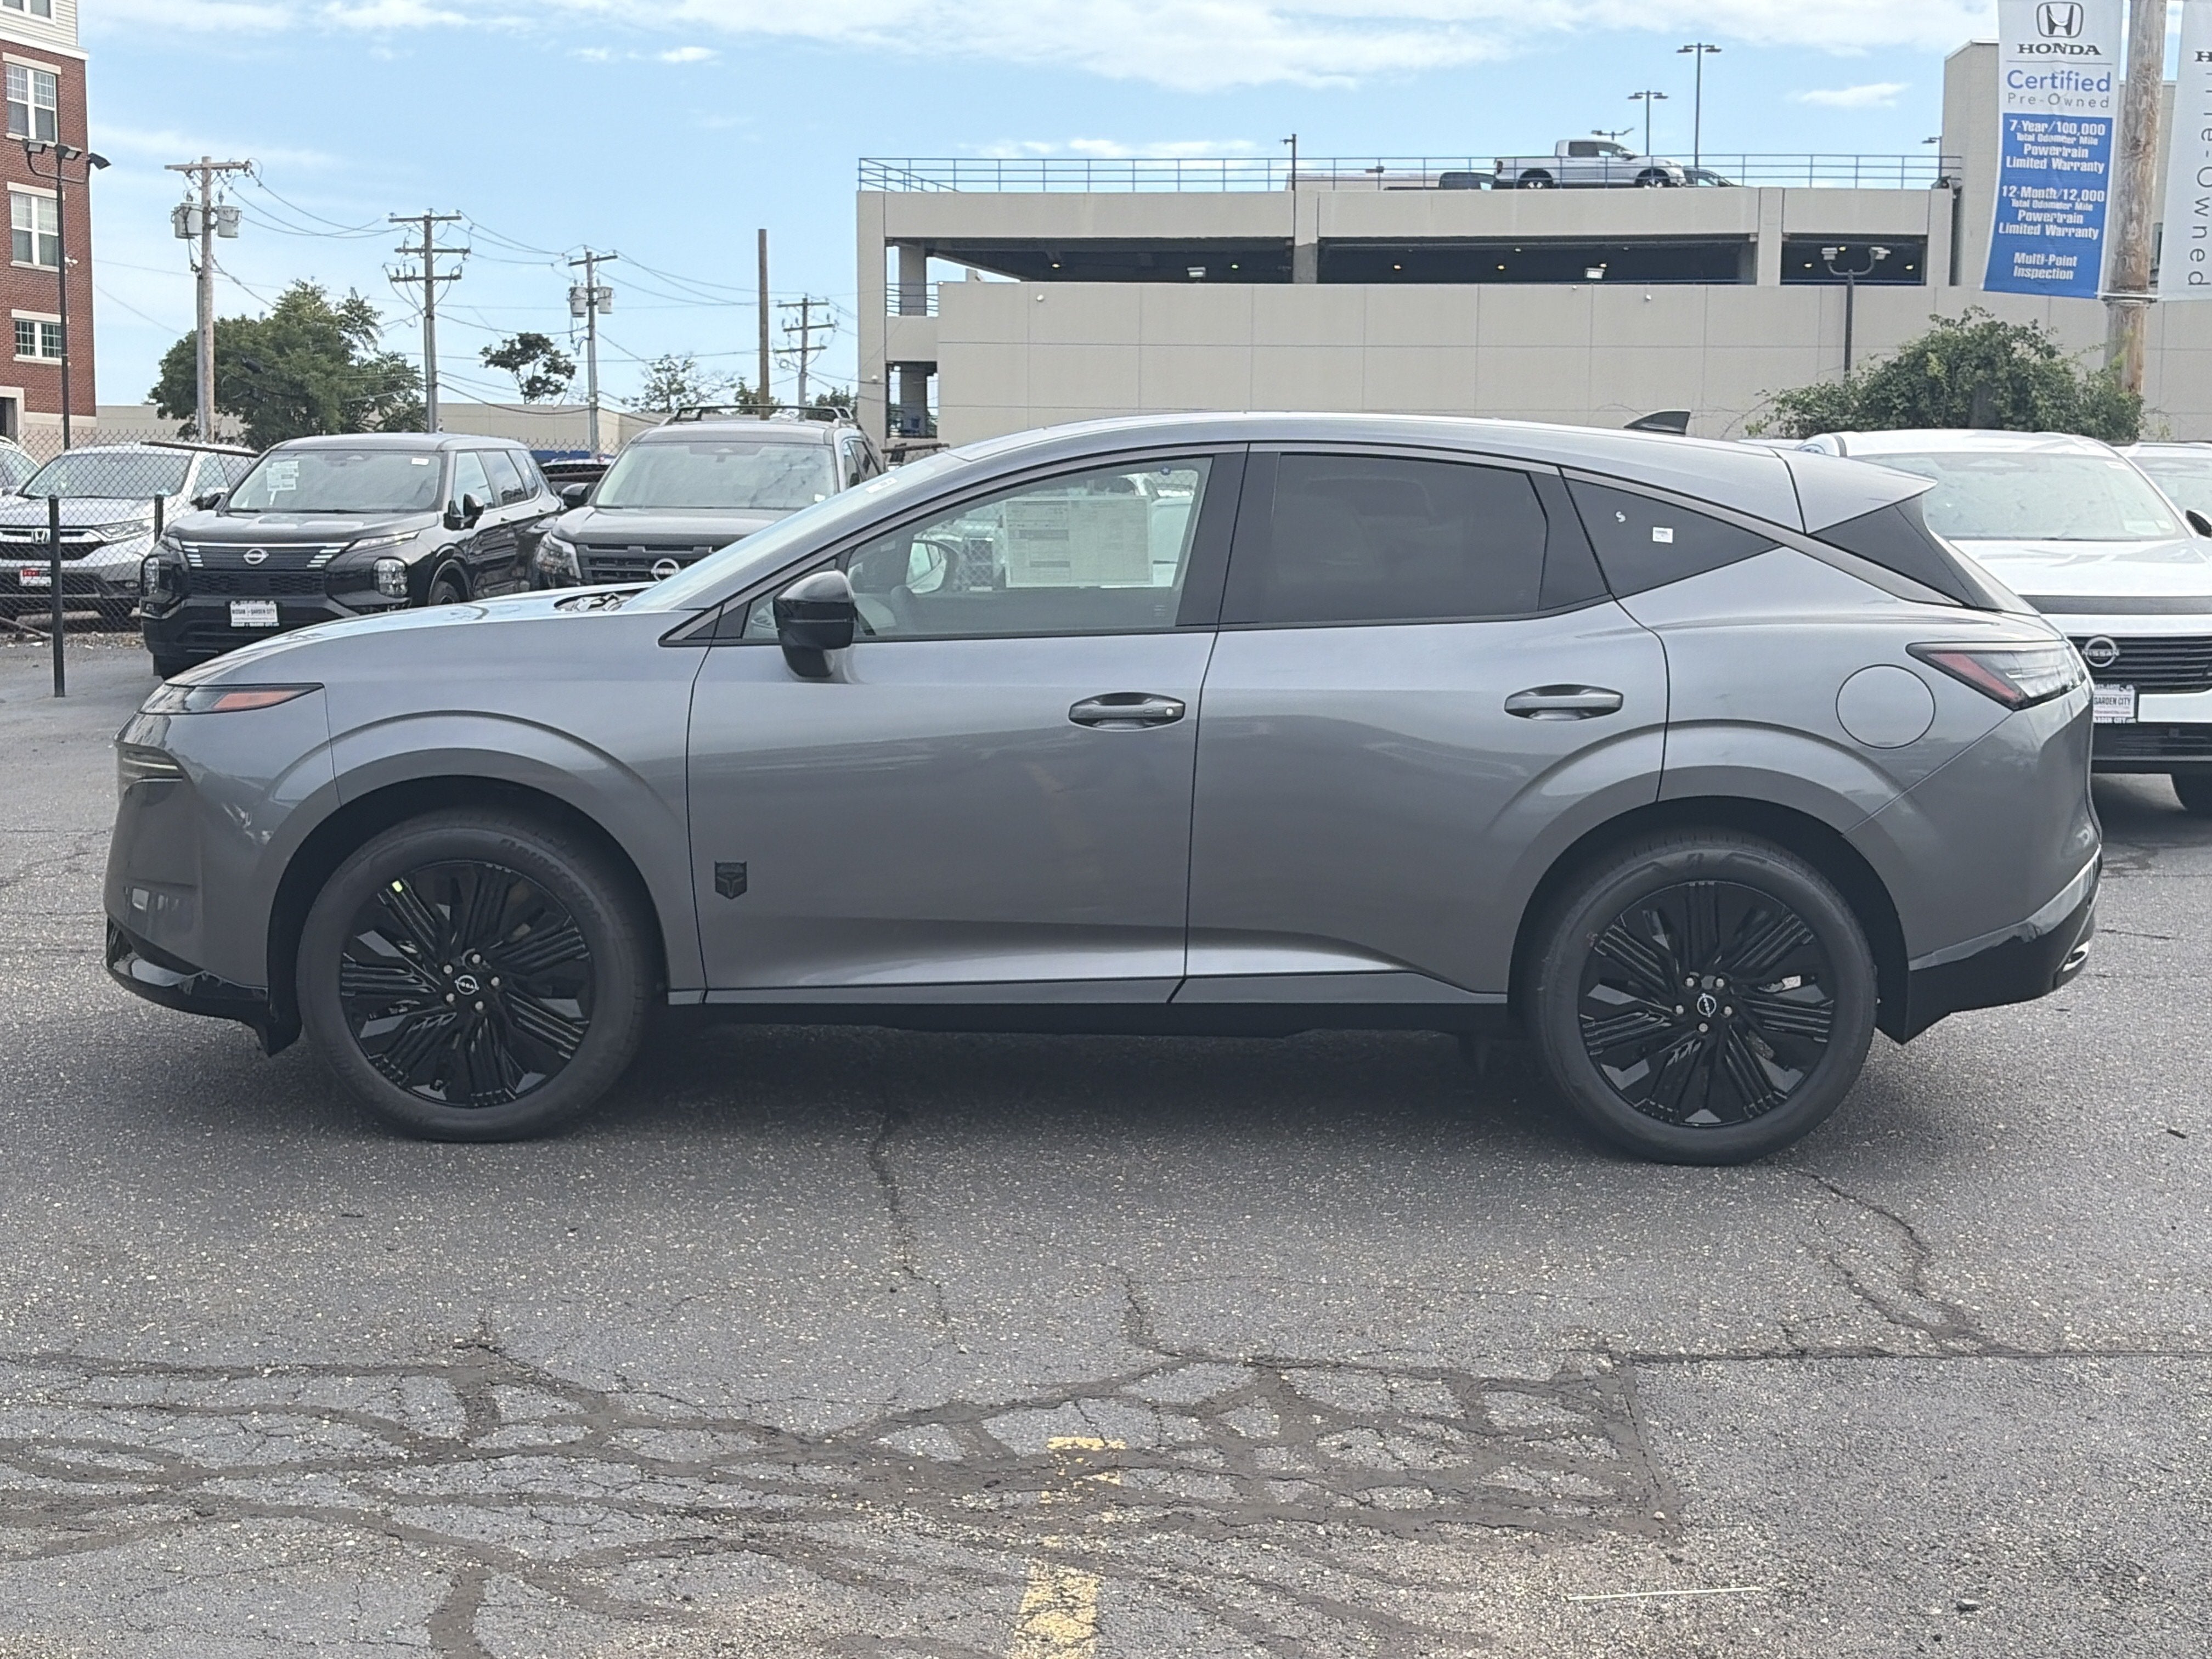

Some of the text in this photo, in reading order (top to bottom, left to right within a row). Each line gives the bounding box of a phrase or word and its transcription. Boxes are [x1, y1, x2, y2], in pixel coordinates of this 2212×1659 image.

[2017, 43, 2102, 55] HONDA
[2007, 70, 2111, 92] Certified
[2008, 92, 2109, 108] Pre-Owned
[2009, 119, 2106, 136] 7-Year/100,000
[2016, 133, 2035, 142] Total
[2023, 143, 2089, 159] Powertrain
[2006, 156, 2105, 174] Limited Warranty
[2002, 185, 2105, 202] 12-Month/12,000
[2011, 198, 2029, 208] Total
[2017, 210, 2084, 225] Powertrain
[1999, 222, 2100, 240] Limited Warranty
[2013, 252, 2078, 267] Multi-Point
[2013, 265, 2074, 280] Inspection
[2081, 648, 2120, 657] NISSAN
[2118, 697, 2131, 706] CITY
